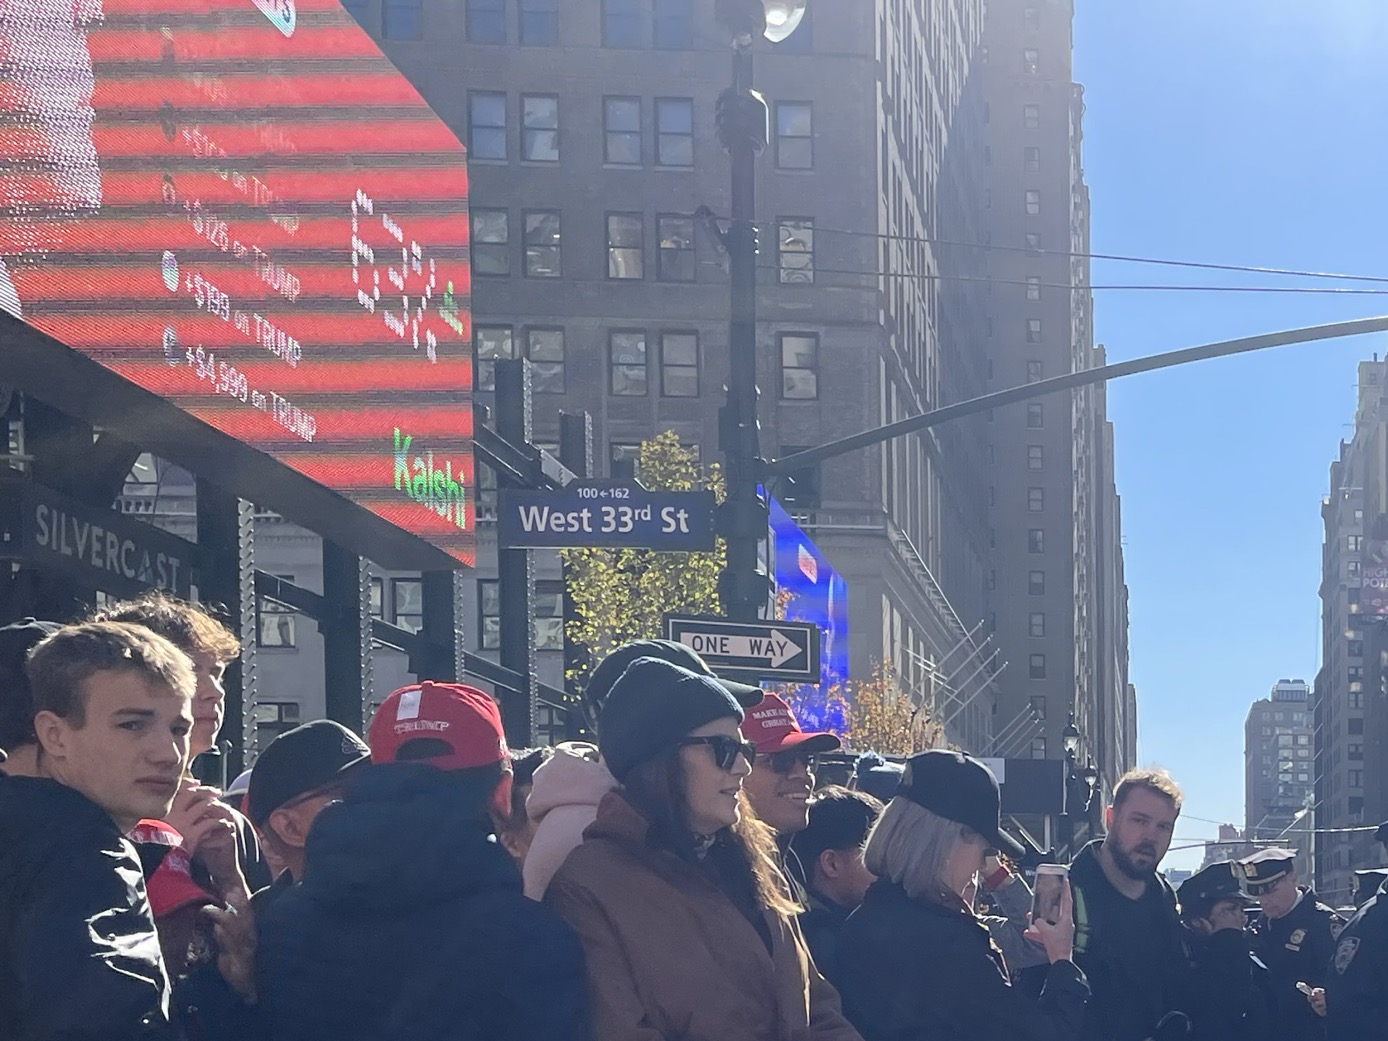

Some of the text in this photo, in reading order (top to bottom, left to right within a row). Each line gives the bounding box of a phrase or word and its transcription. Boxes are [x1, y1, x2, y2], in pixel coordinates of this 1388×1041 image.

[252, 245, 301, 303] TRUMP
[185, 271, 302, 368] +$199 on TRUMP
[186, 344, 317, 442] +$4,999 on TRUMP
[394, 426, 466, 530] Kalshi
[576, 487, 630, 500] 100 162
[518, 503, 690, 534] West 33rd St
[35, 503, 182, 593] SILVERCAST
[691, 635, 789, 659] ONE WAY
[394, 719, 450, 734] TRUMP
[752, 708, 778, 720] MAKE
